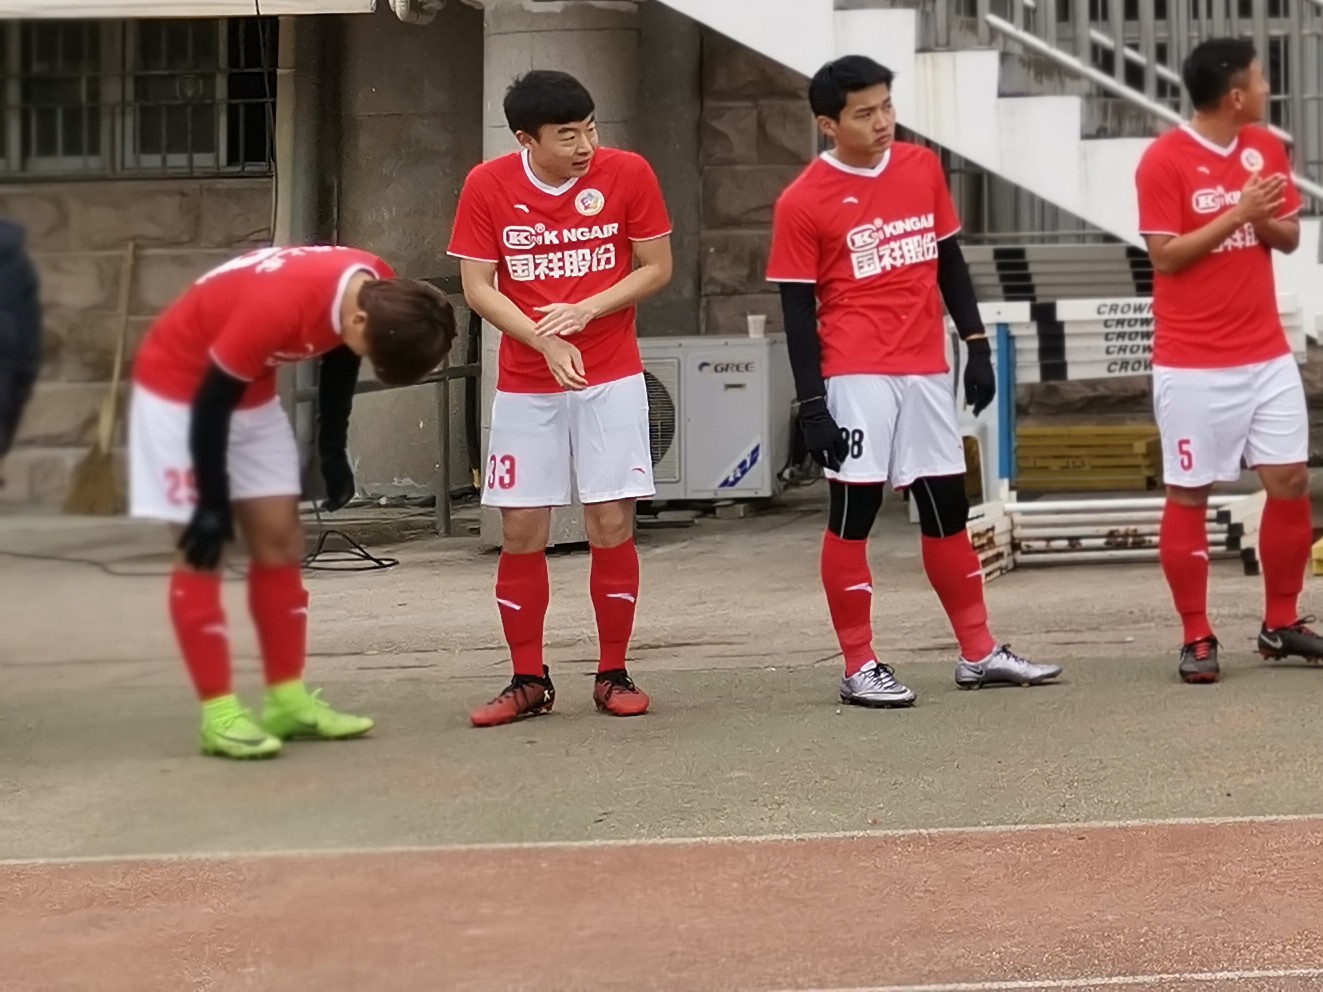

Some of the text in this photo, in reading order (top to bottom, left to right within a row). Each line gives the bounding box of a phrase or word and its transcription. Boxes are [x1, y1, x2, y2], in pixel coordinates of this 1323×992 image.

[543, 222, 619, 246] KNGAIR
[504, 242, 616, 282] 国祥股份
[849, 230, 939, 280] 国祥股份
[713, 361, 756, 374] GREE
[1177, 438, 1194, 472] 5
